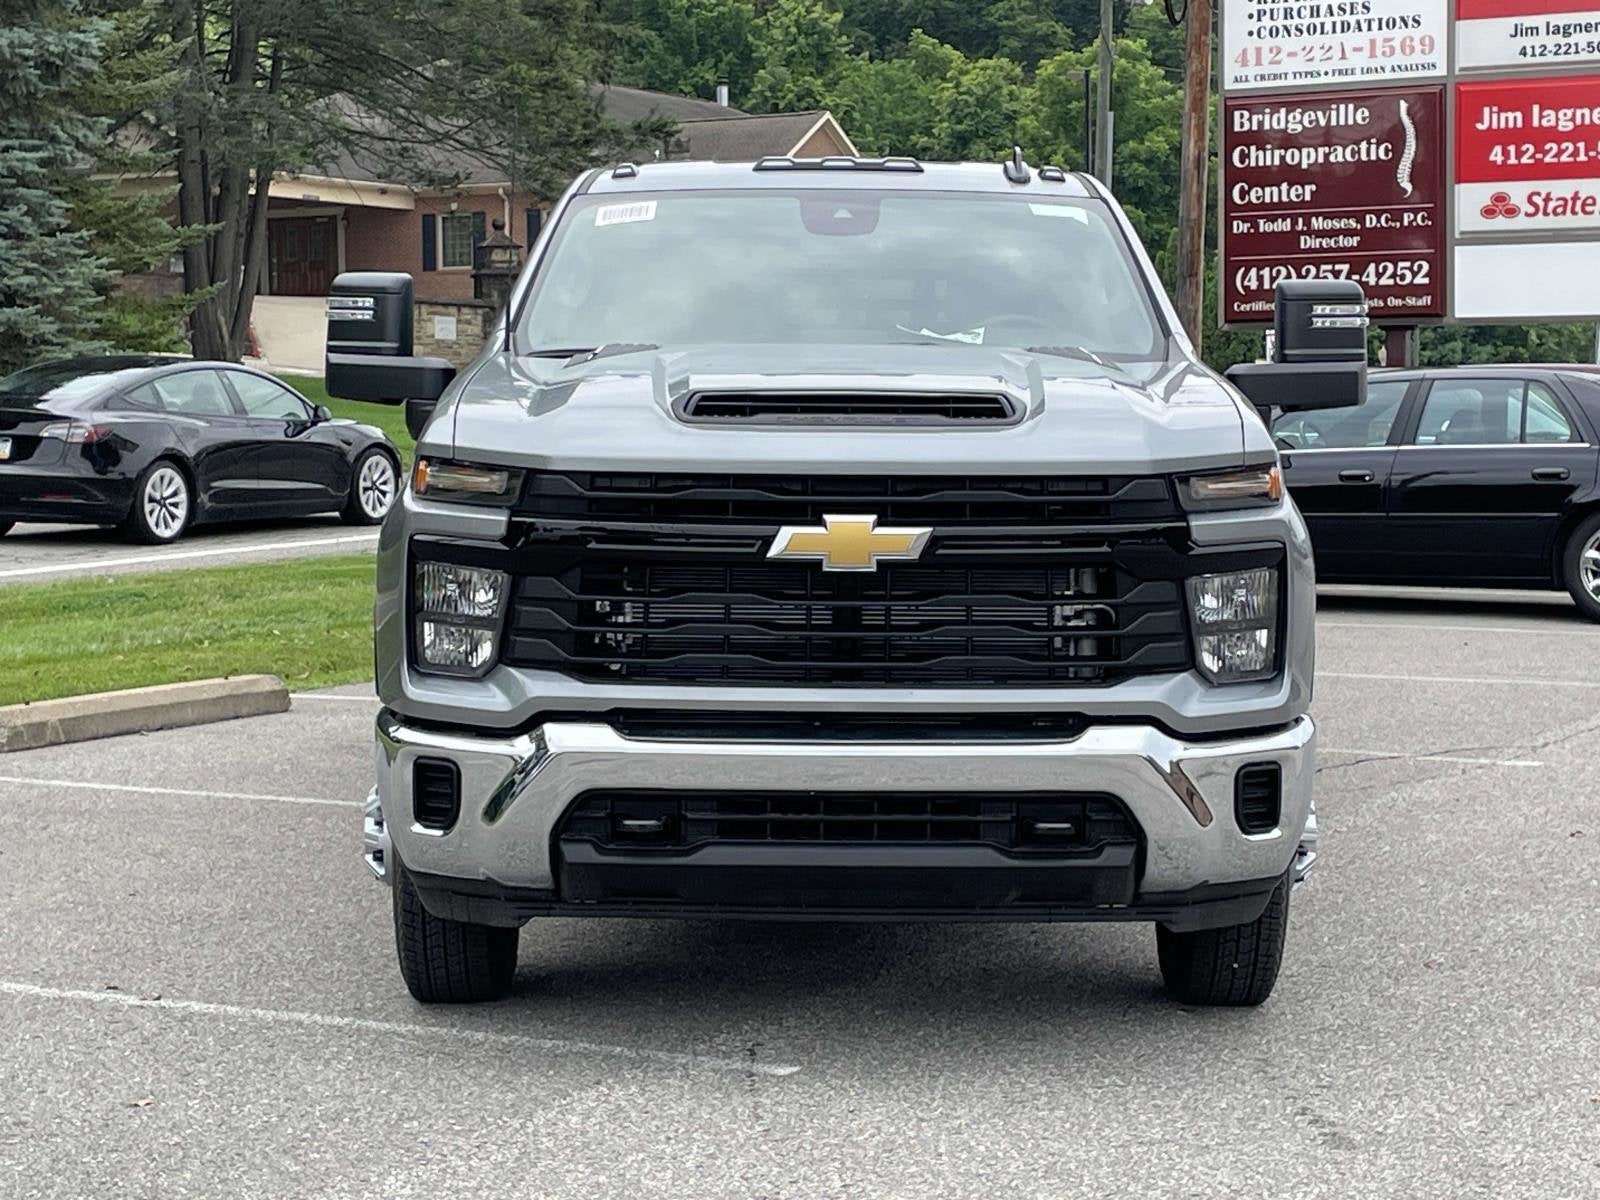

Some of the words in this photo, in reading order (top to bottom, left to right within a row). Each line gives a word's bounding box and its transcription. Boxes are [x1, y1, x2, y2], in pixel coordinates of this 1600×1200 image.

[1256, 14, 1422, 40] CONSOLIDATIONS
[1509, 22, 1539, 38] Jim
[1234, 34, 1436, 68] 412-221-1569
[1232, 74, 1250, 84] ALL
[1254, 72, 1288, 82] CREDIT
[1292, 69, 1322, 79] TYPES
[1331, 67, 1357, 77] FREE
[1360, 65, 1386, 75] LOAN
[1389, 62, 1438, 74] ANALYSIS
[1233, 103, 1370, 134] Bridgeville
[1475, 106, 1523, 131] Jim
[1232, 138, 1393, 169] Chiropractic
[1489, 141, 1600, 165] 412-221-
[1232, 182, 1317, 205] Center
[1524, 190, 1597, 218] State
[1232, 220, 1255, 234] Dr.
[1258, 218, 1291, 232] Todd
[1295, 217, 1307, 231] J.
[1311, 215, 1361, 230] Moses,
[1403, 212, 1432, 226] P.C.
[1299, 235, 1361, 249] Director
[1387, 295, 1432, 307] On-Staff
